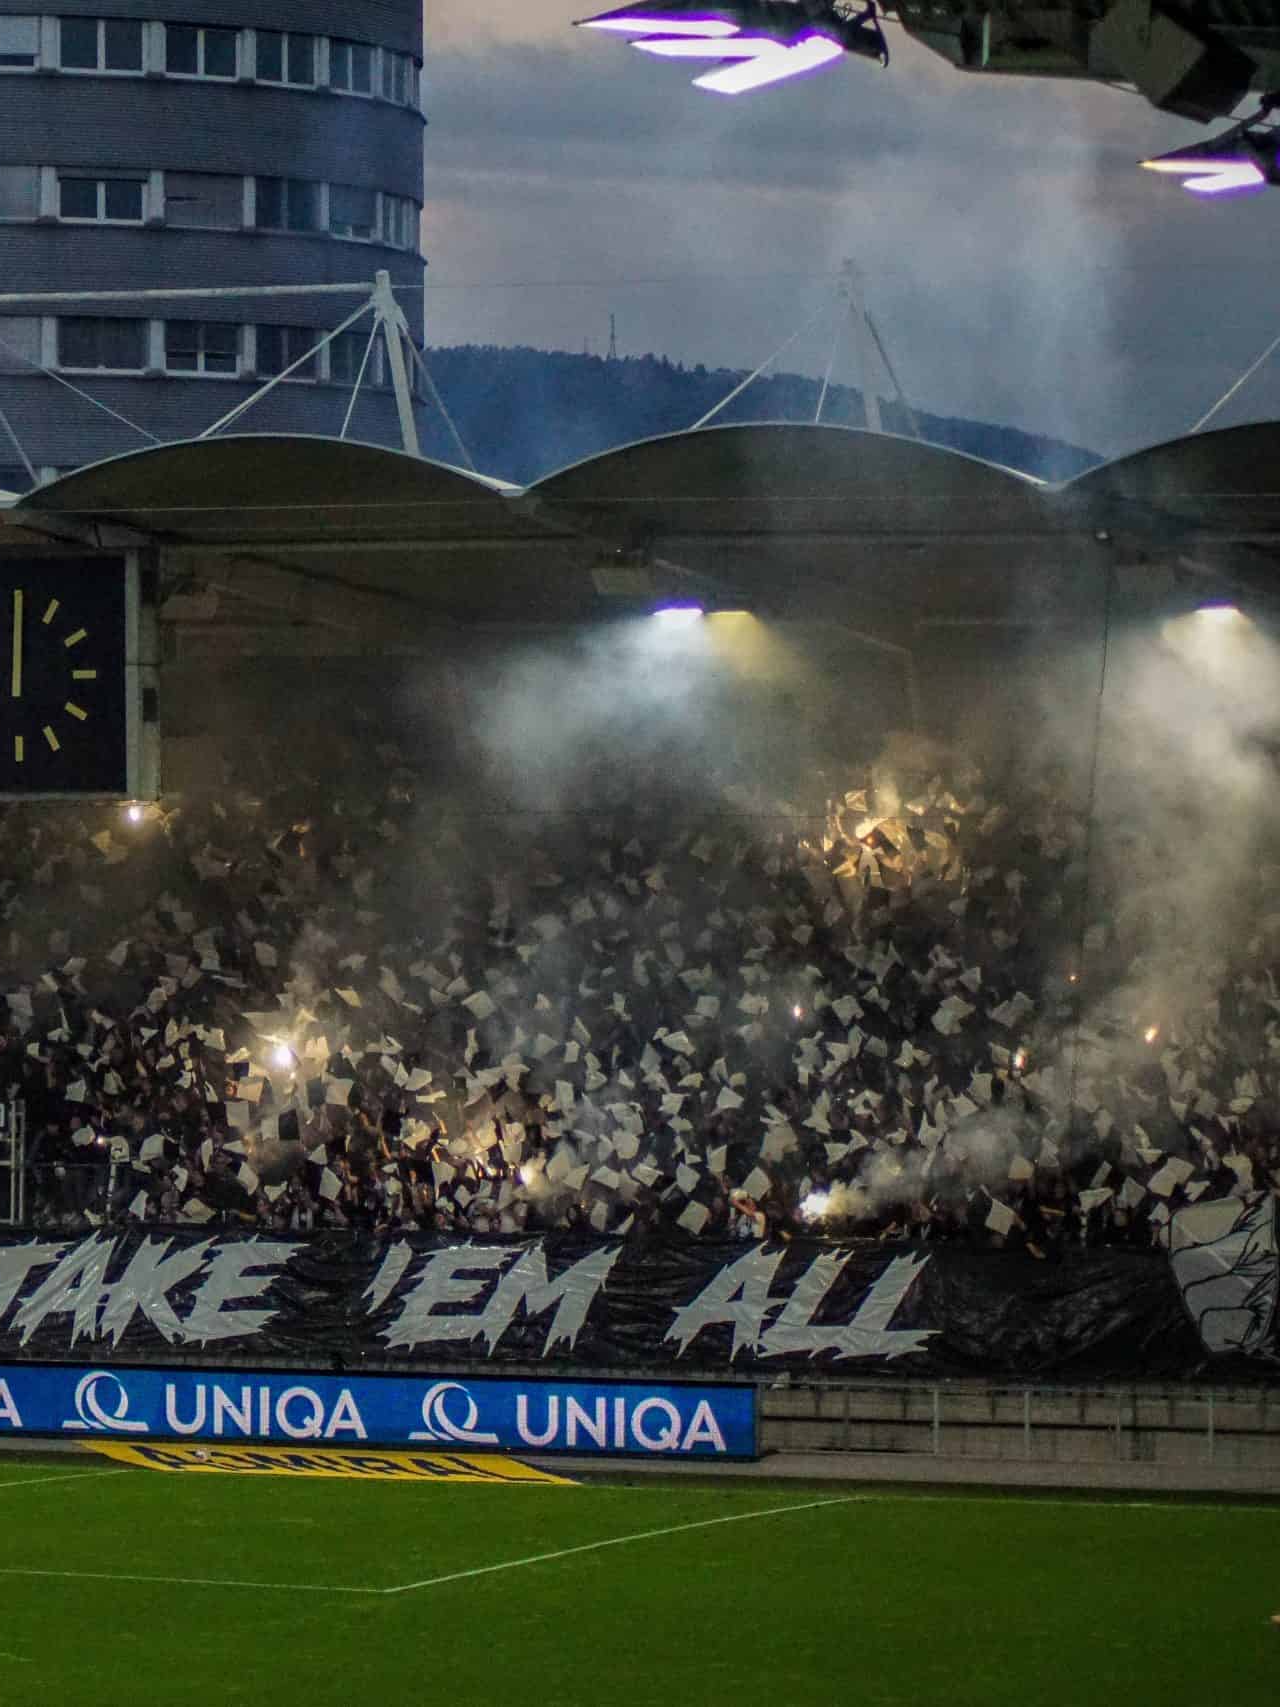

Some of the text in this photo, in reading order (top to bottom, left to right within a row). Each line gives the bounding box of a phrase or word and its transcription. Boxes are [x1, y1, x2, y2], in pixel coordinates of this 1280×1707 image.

[663, 1240, 942, 1362] ALL
[166, 1383, 368, 1439] UNIQA
[516, 1396, 726, 1451] UNIQA
[129, 1445, 556, 1484] ADMIRAL
